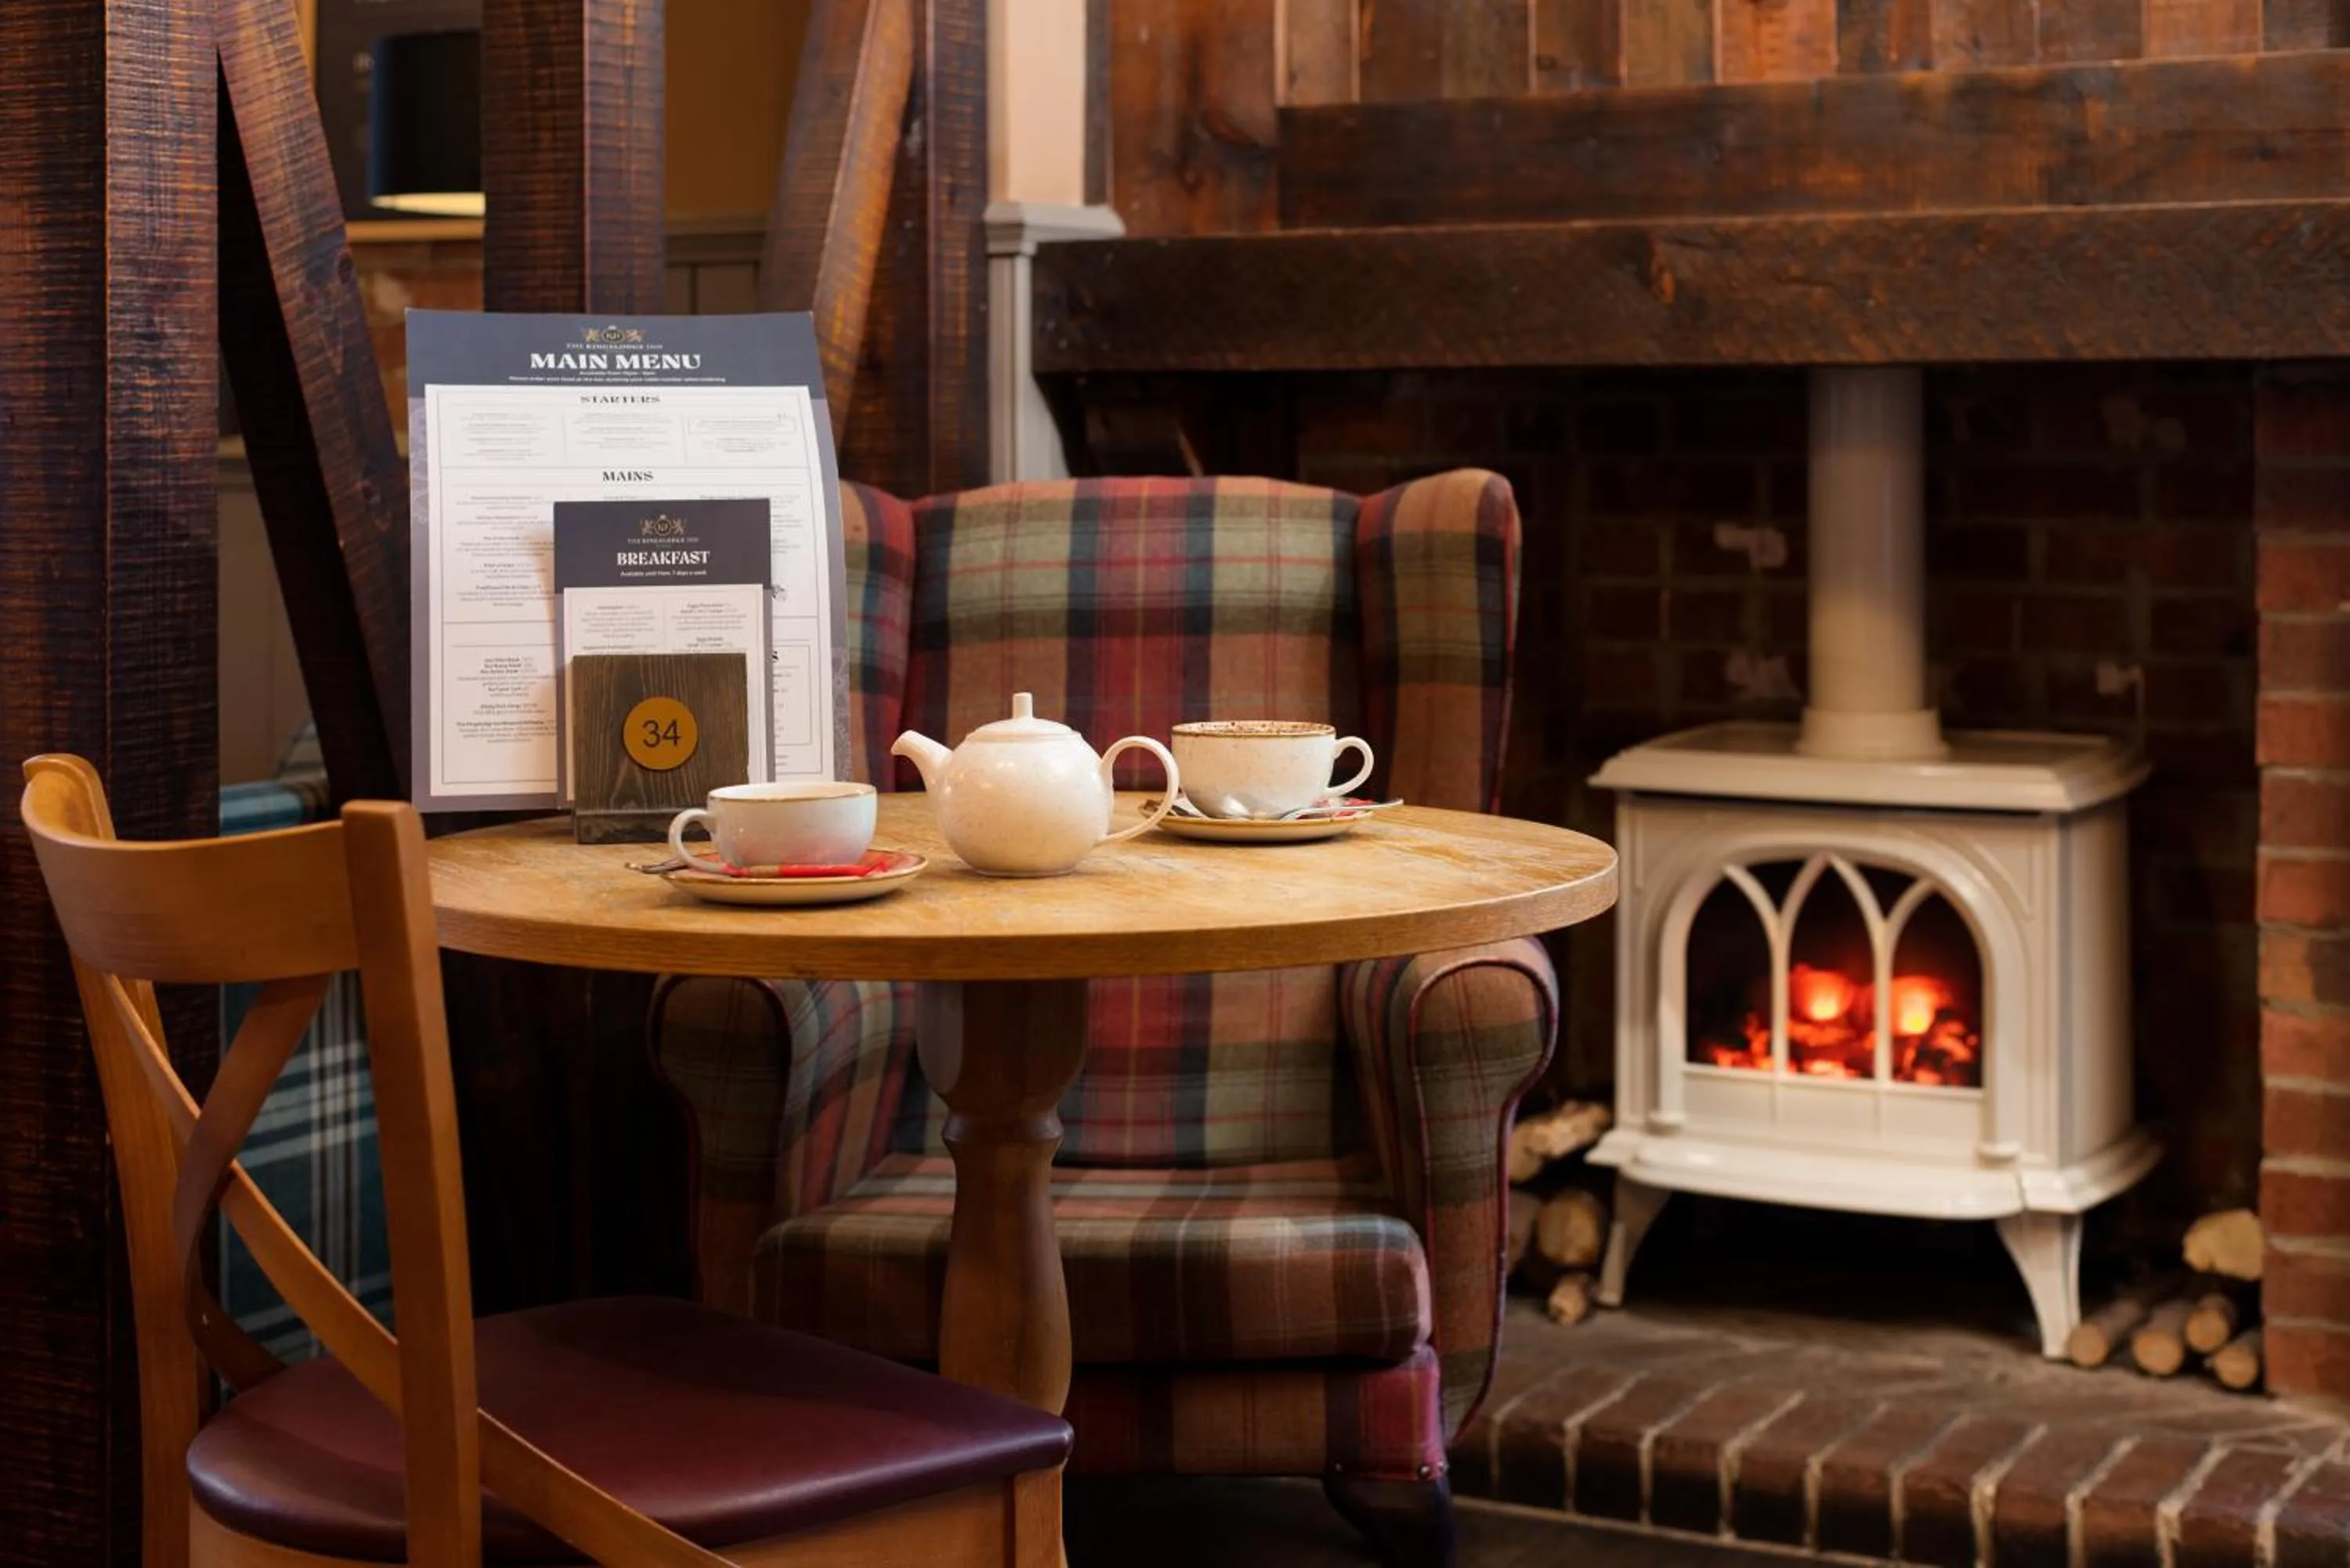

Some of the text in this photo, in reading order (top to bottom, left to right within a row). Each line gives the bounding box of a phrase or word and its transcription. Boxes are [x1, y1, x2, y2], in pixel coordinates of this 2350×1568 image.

[530, 353, 701, 370] MAIN MENU
[580, 395, 660, 404] STARTERS
[602, 471, 653, 482] MAINS
[616, 551, 710, 566] BREAKFAST
[642, 719, 682, 748] 34
